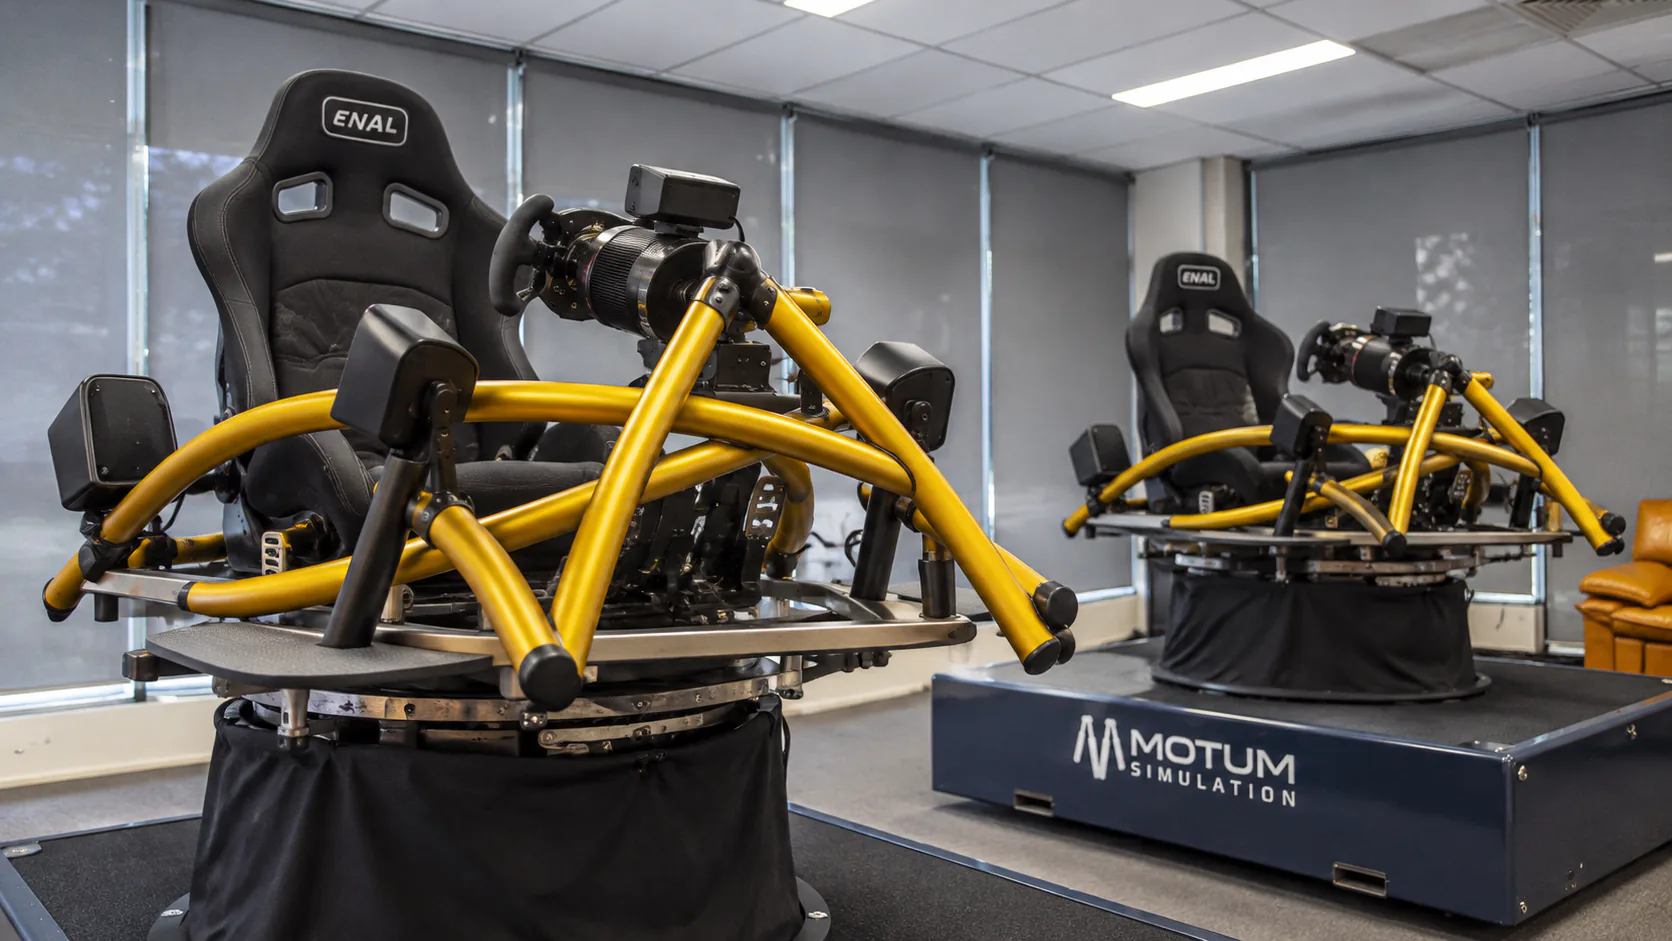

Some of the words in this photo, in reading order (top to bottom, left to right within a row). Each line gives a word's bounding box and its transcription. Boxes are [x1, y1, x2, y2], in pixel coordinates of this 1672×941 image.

[333, 109, 398, 134] ENAL
[1182, 271, 1216, 285] ENAL
[1130, 729, 1295, 785] MOTUM
[1130, 761, 1296, 807] SIMULATION
